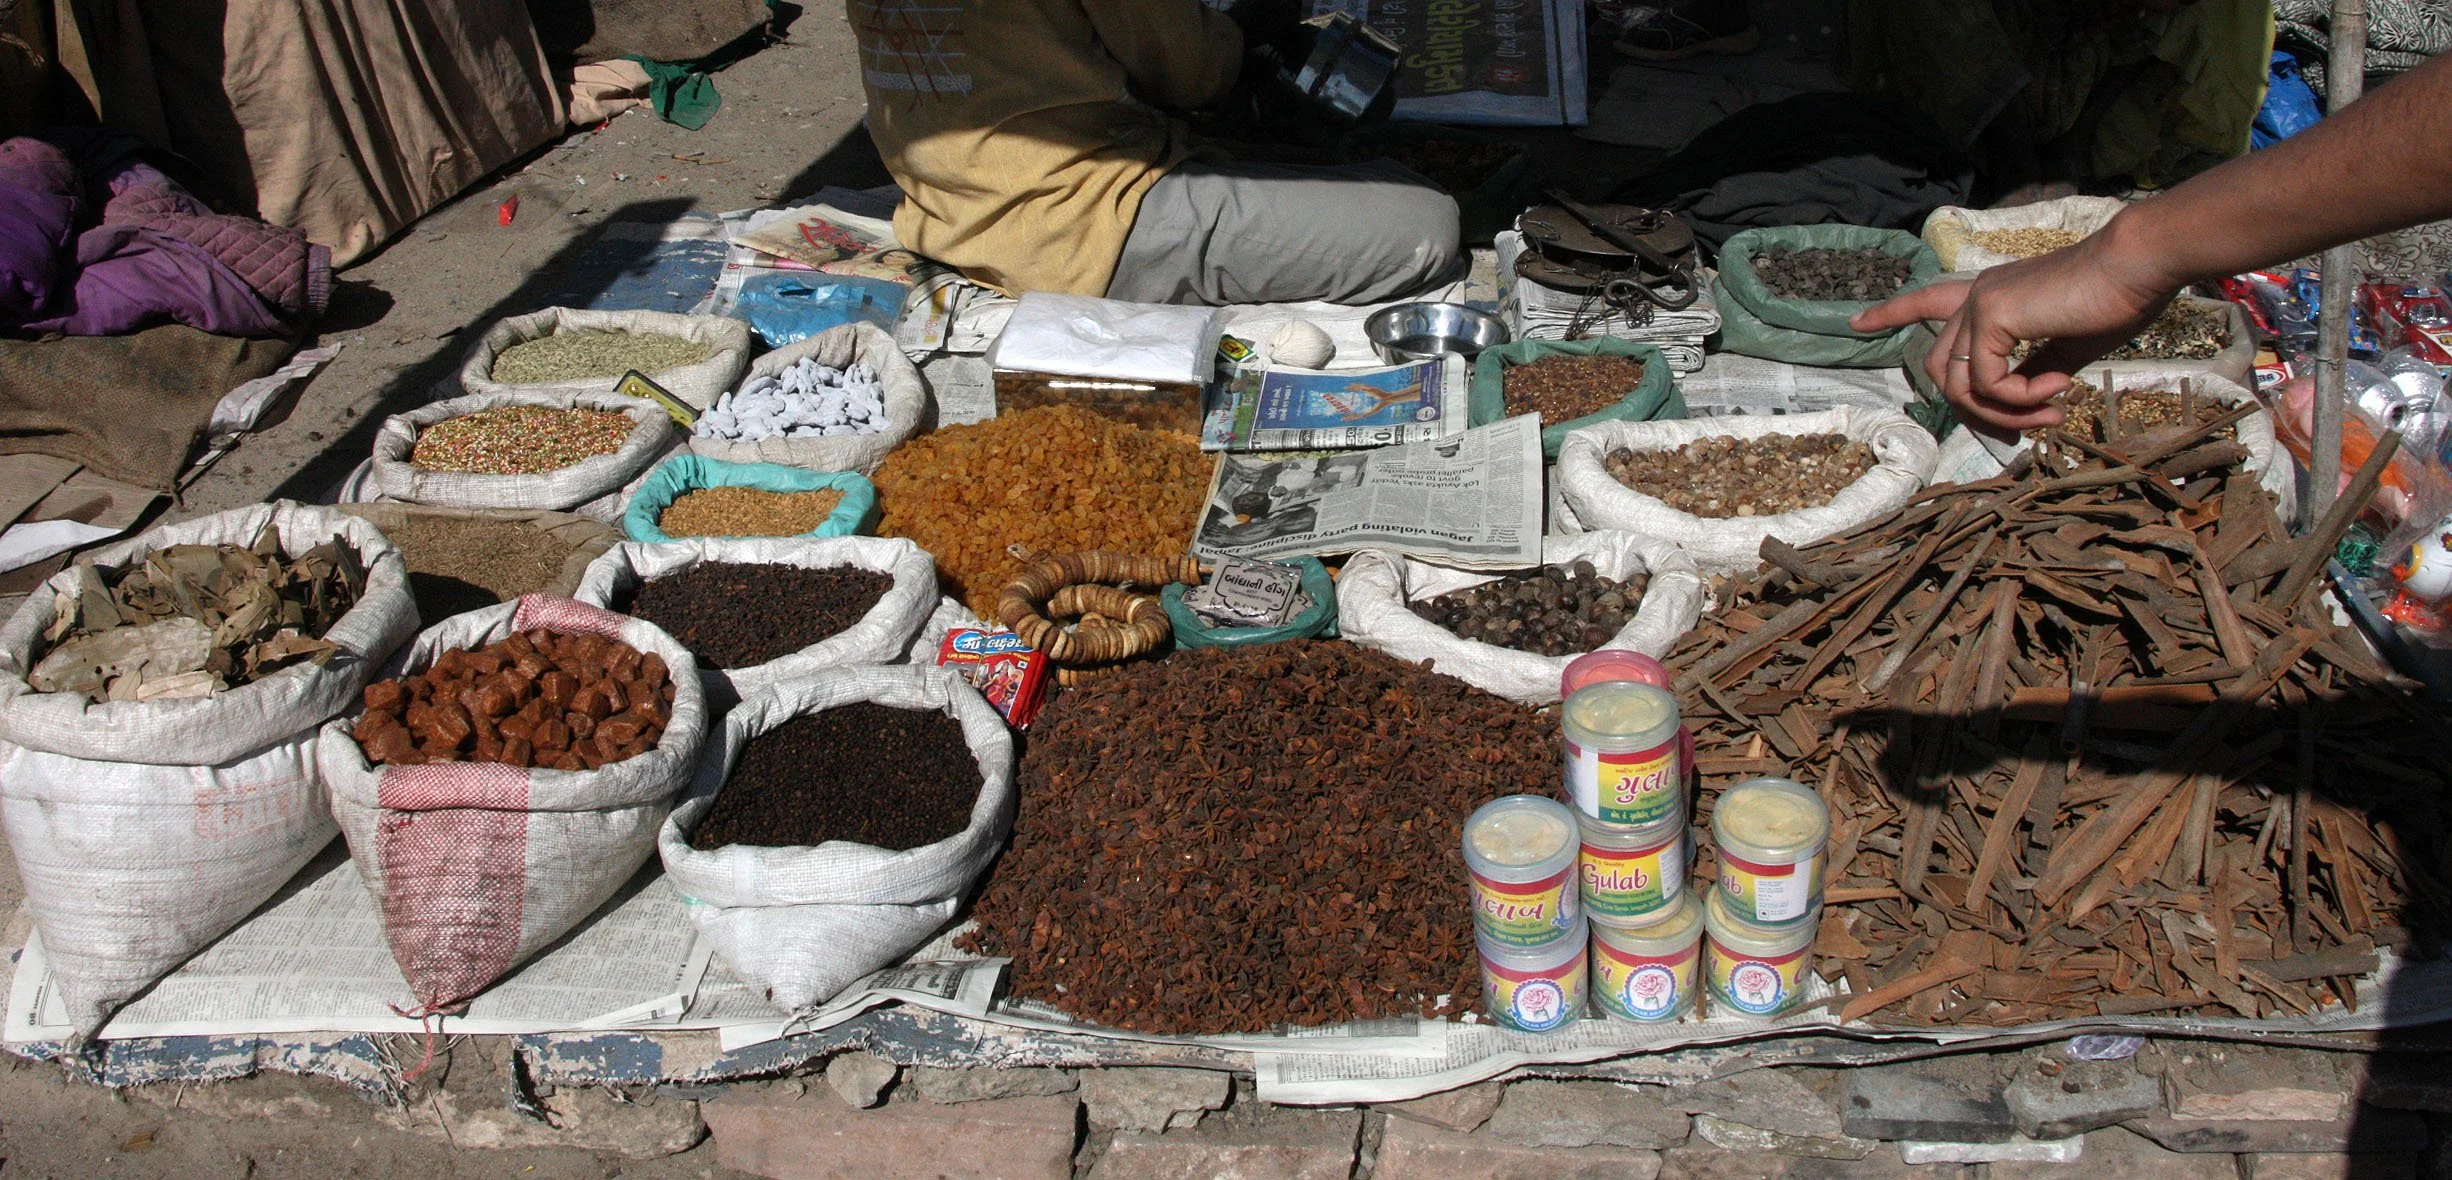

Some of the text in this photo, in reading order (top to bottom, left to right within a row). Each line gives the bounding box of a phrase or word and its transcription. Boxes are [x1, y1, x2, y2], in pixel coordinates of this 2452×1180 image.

[1438, 466, 1474, 477] parallel
[1425, 481, 1461, 489] Ayukta
[1464, 480, 1480, 489] Lok
[1321, 523, 1358, 537] party
[1361, 522, 1427, 536] violating
[1430, 529, 1475, 542] Jagan
[1245, 532, 1317, 550] discipline:
[1615, 766, 1674, 804] ગુલા
[1582, 863, 1648, 895] Gulab
